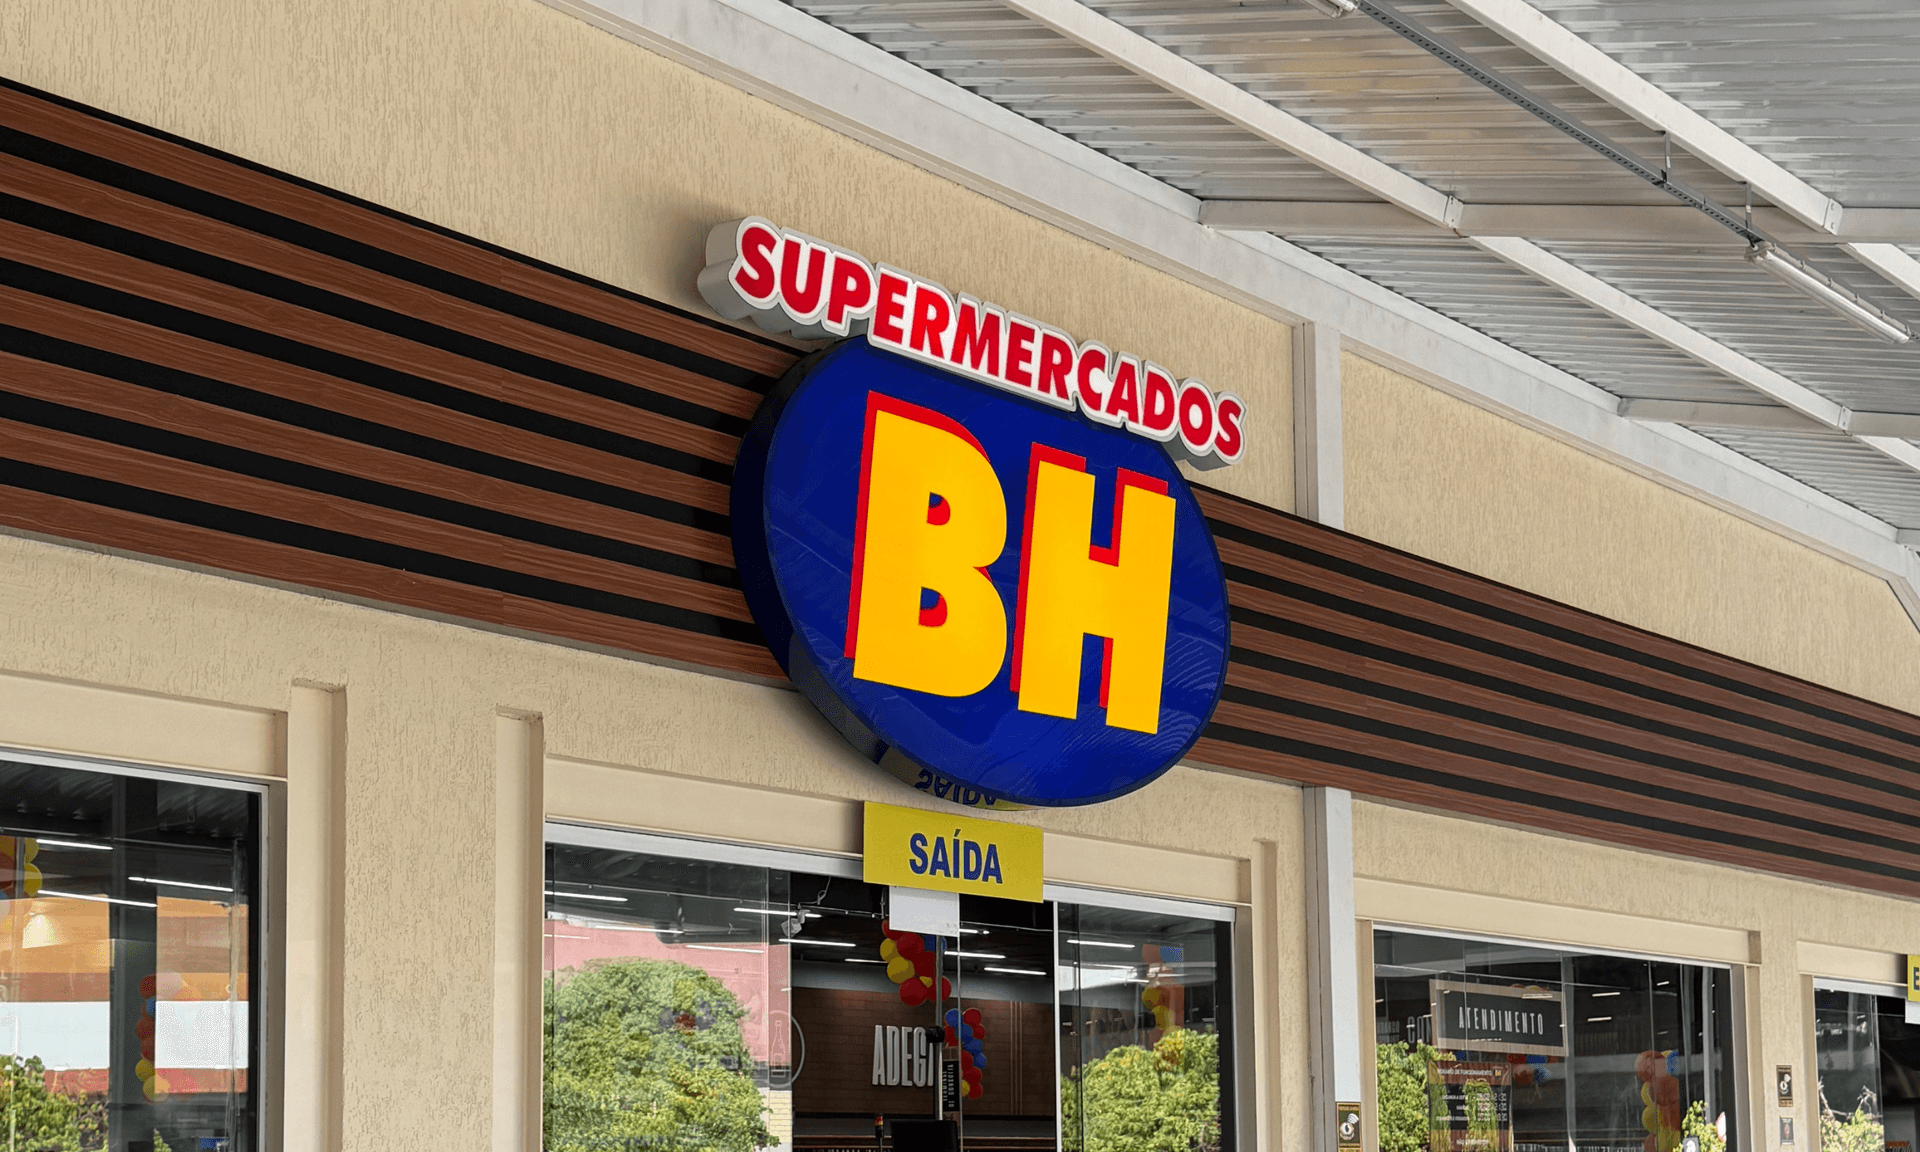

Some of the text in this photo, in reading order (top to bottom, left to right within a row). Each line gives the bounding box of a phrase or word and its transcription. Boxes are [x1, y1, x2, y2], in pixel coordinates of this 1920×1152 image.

[735, 226, 1243, 458] SUPERMERCADOS
[844, 390, 1176, 735] BH
[909, 829, 1003, 884] SAÍDA
[1459, 1006, 1543, 1035] ATENDIMENTO
